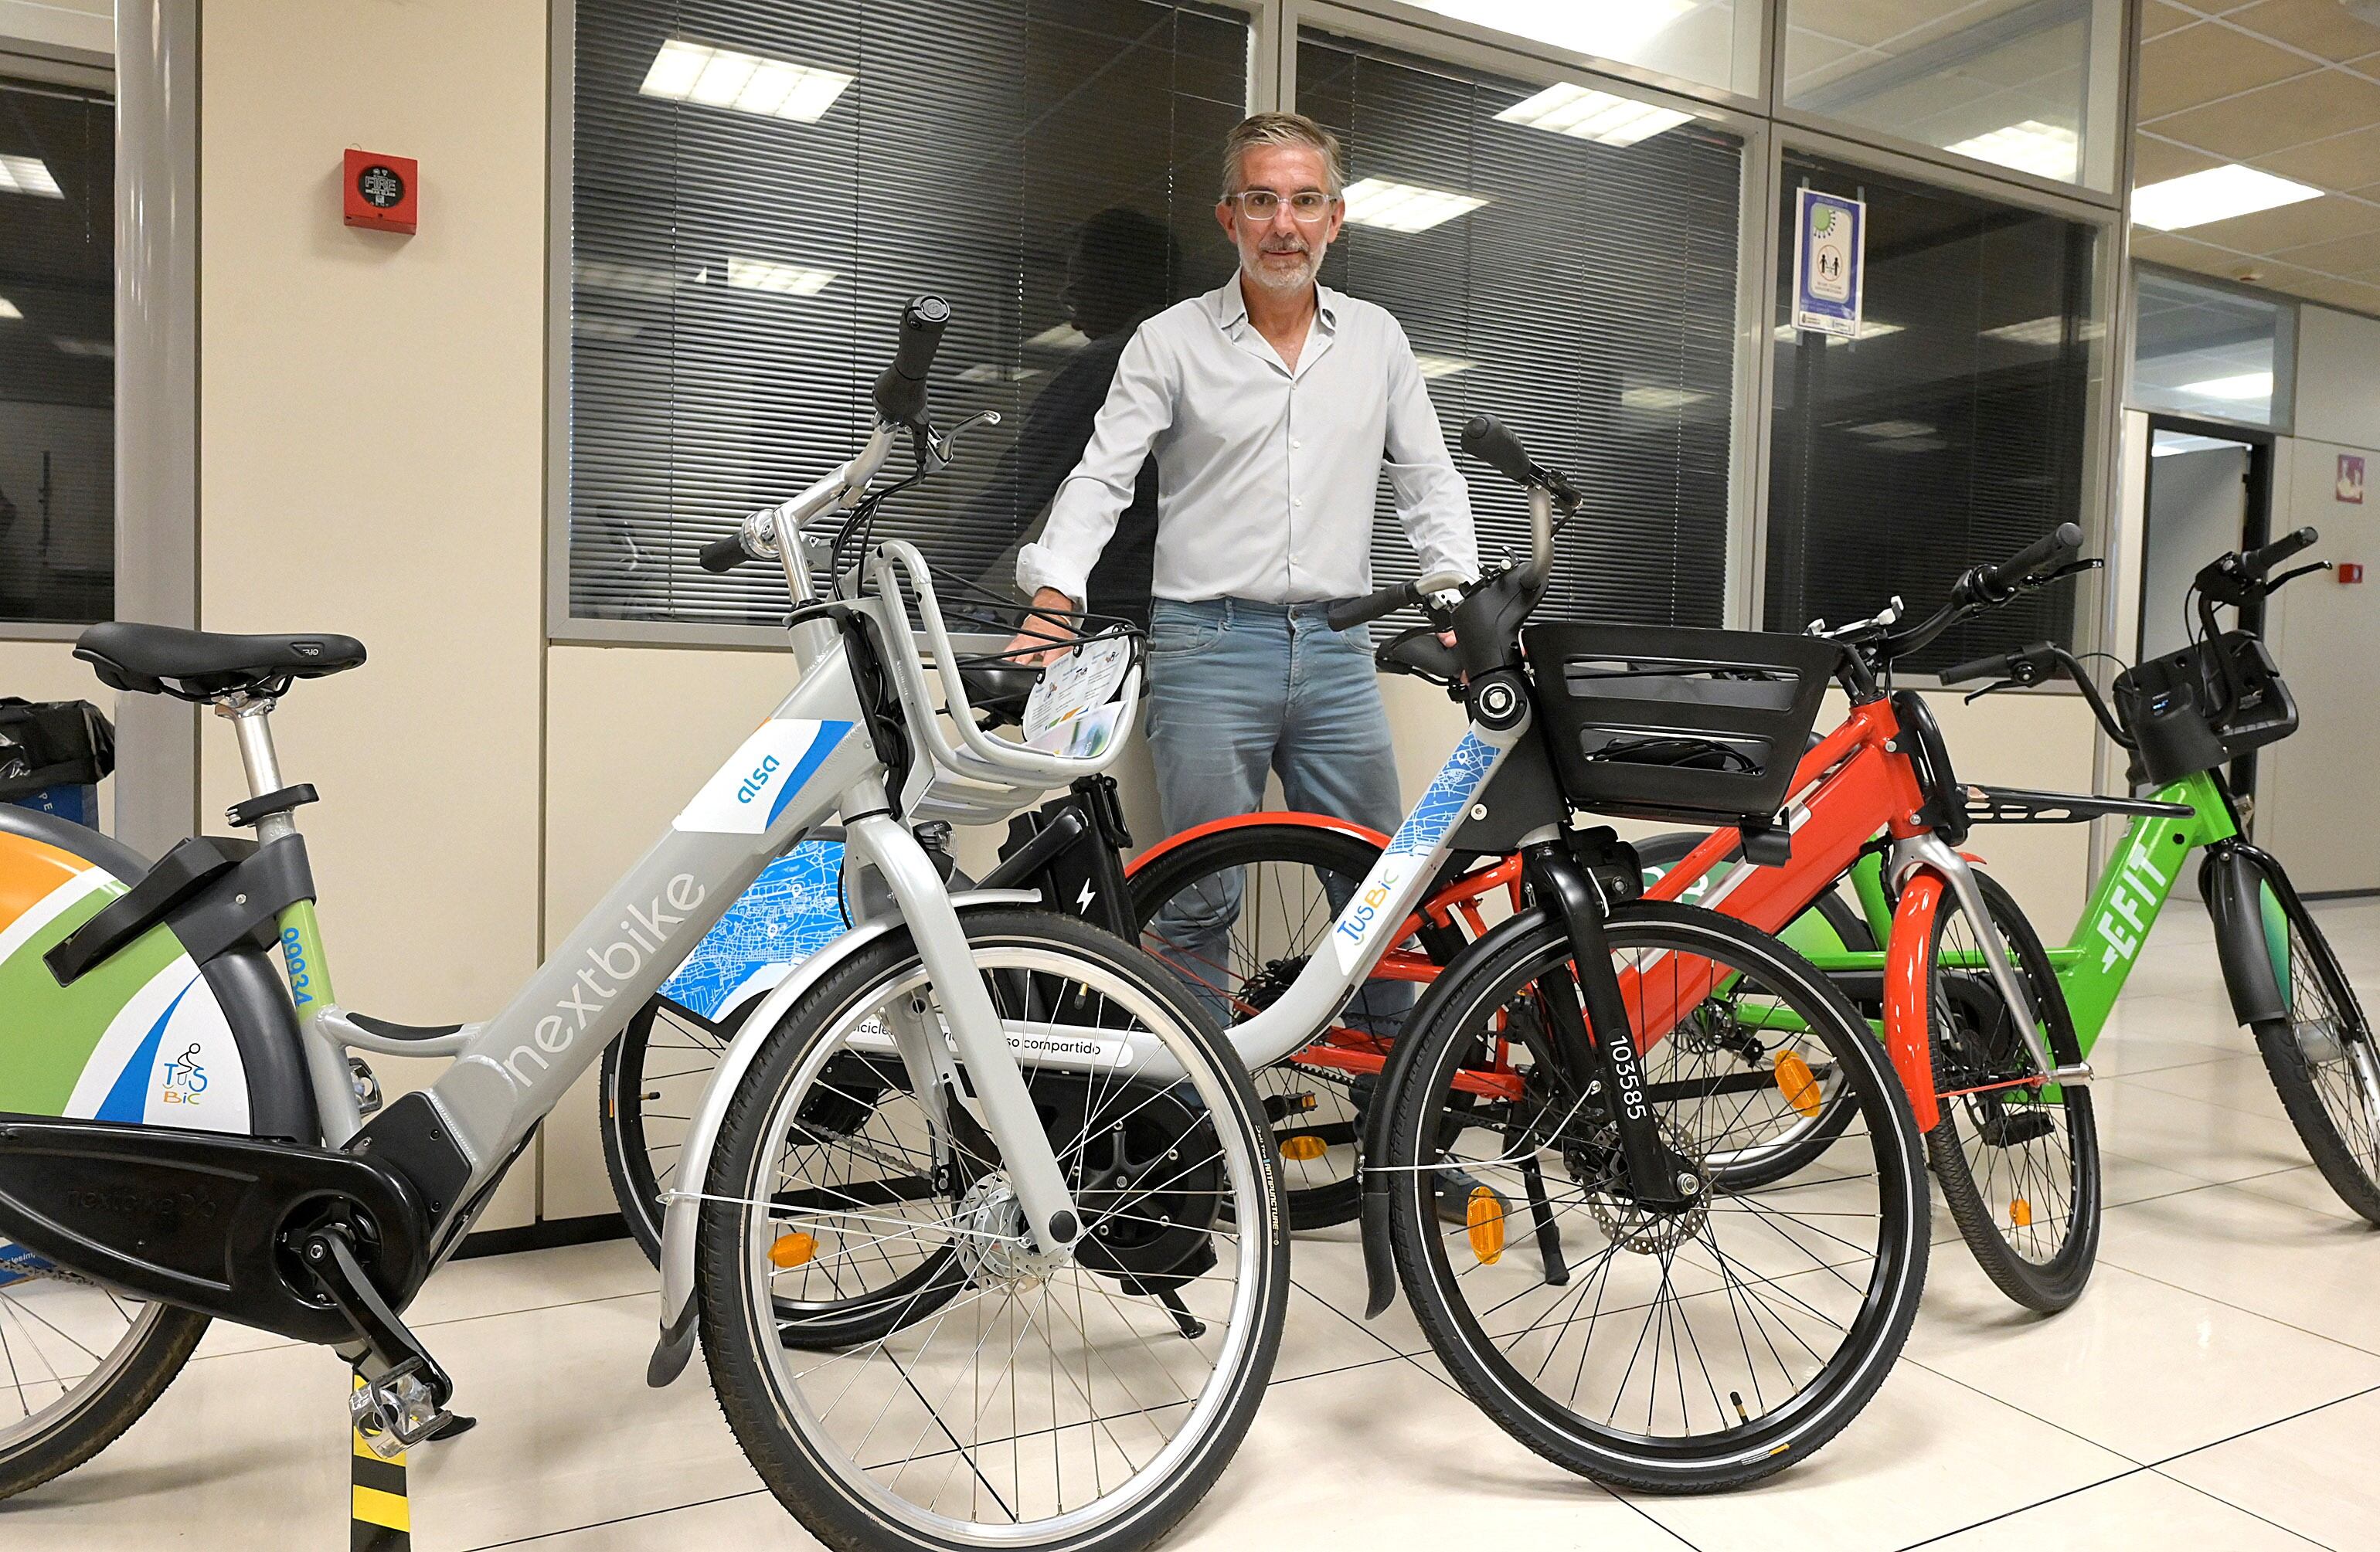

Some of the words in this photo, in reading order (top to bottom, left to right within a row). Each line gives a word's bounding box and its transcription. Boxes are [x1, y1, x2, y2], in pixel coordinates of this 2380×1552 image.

[366, 176, 396, 191] FIRE
[738, 755, 780, 803] alsa
[2096, 843, 2166, 959] EFIT
[502, 873, 705, 1087] nextbike
[1006, 1037, 1019, 1048] so
[1024, 1039, 1100, 1055] compartido
[1610, 1035, 1647, 1119] 103585
[1264, 1163, 1279, 1231] ANTIPUNCTURE
